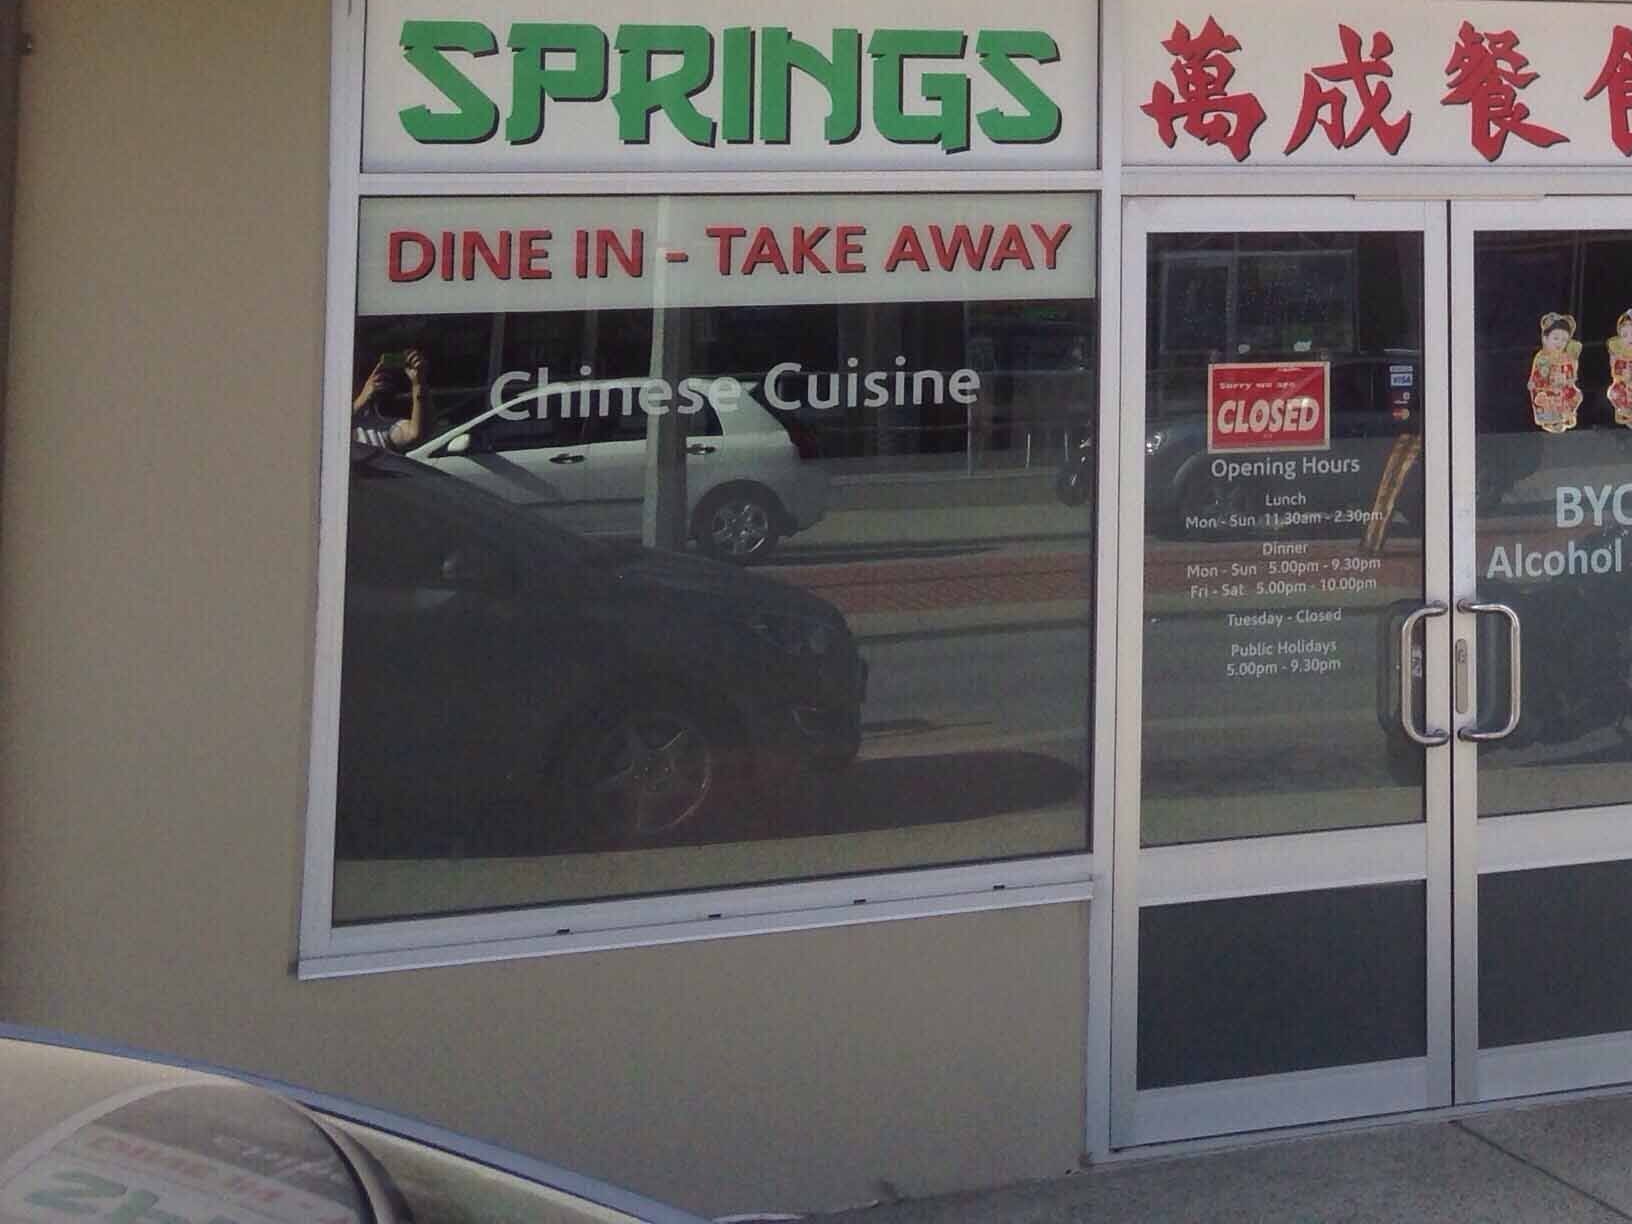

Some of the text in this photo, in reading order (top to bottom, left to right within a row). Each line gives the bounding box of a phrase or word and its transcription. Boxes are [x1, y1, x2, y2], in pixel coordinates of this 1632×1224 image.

[399, 20, 1062, 153] SPRINGS
[387, 228, 553, 283] DINE
[575, 228, 644, 279] IN
[705, 225, 867, 276] TAKE
[885, 223, 1072, 273] AWAY
[489, 355, 981, 421] Chinese Cuisine
[1217, 396, 1320, 434] CLOSED
[1211, 456, 1361, 481] Opening Hours
[1265, 491, 1307, 507] Lunch
[1185, 516, 1217, 529] Mon
[1231, 514, 1256, 527] Sun
[1264, 511, 1322, 527] 11.30am
[1333, 509, 1384, 525] 2.30pm
[1262, 542, 1310, 556] Dinner
[1486, 537, 1623, 580] Alcohol
[1187, 564, 1218, 579] Mon
[1231, 562, 1257, 576] Sun
[1268, 560, 1319, 577] 5.00pm
[1331, 557, 1381, 574] 9.30pm
[1190, 584, 1209, 599] Fri
[1221, 583, 1246, 597] Sat
[1256, 580, 1307, 597] 5.00pm
[1318, 576, 1377, 594] 10.00pm
[1227, 612, 1284, 628] Tuesday
[1295, 608, 1342, 624] Closed
[1231, 639, 1338, 657] Public Holidays
[1227, 661, 1279, 678] 5.00pm
[1290, 657, 1342, 674] 9.30pm
